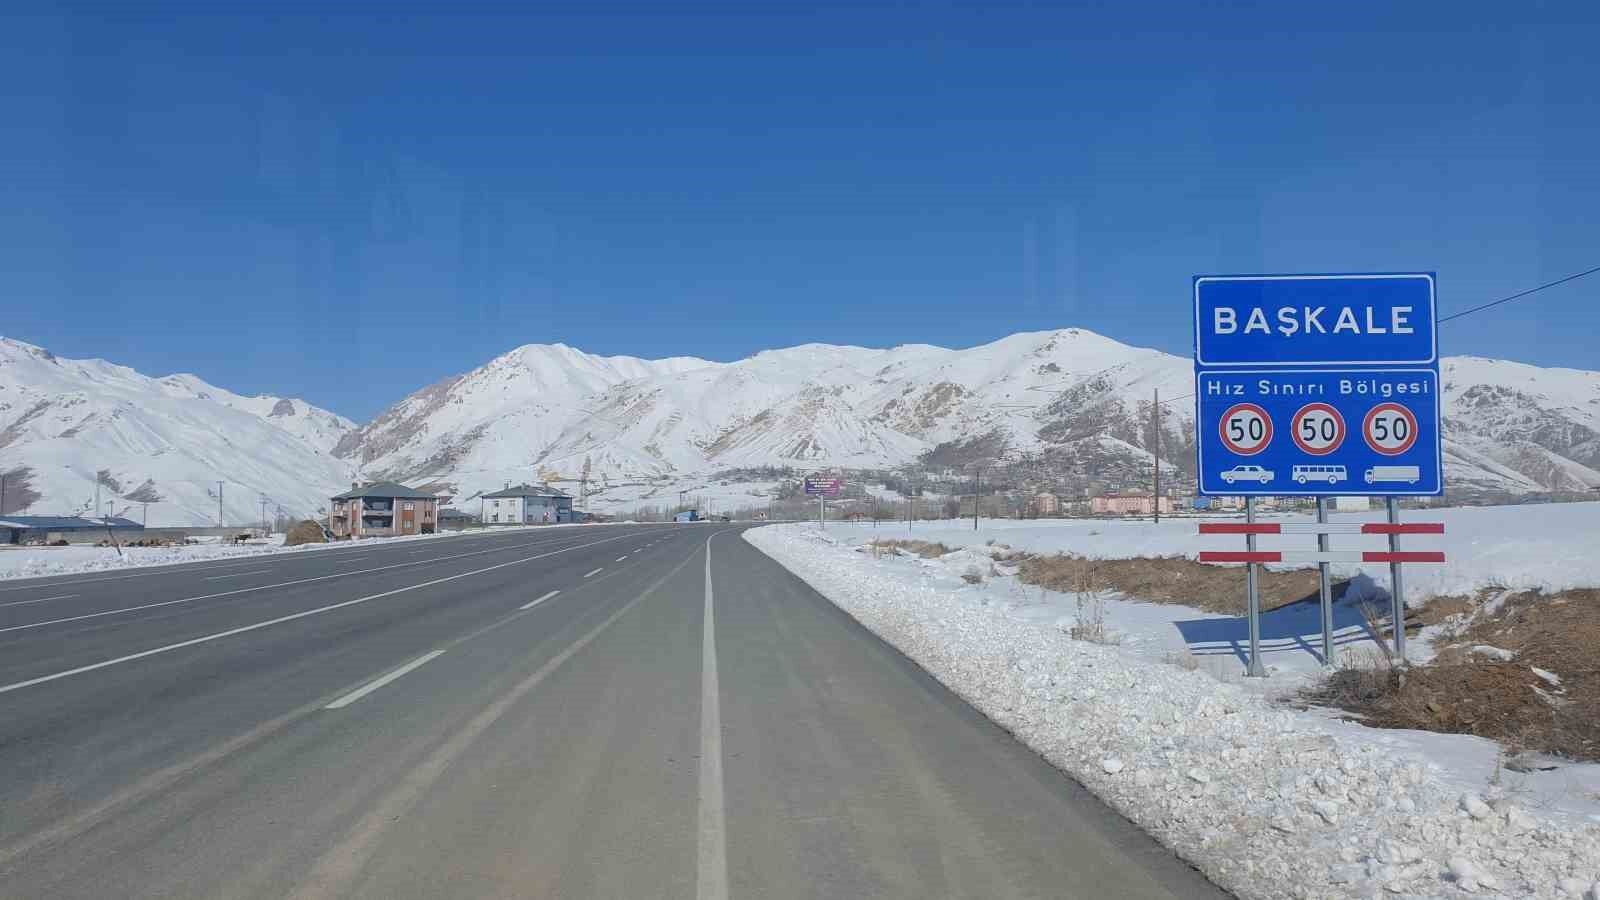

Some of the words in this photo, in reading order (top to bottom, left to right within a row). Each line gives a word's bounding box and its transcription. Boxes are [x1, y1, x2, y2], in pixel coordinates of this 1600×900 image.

[1214, 306, 1414, 337] BAŞKALE
[1207, 380, 1245, 396] Hız
[1258, 380, 1324, 395] Sınırı
[1340, 379, 1429, 398] Bölgesi
[1230, 418, 1264, 442] 50
[1302, 418, 1336, 442] 50
[1374, 417, 1408, 441] 50
